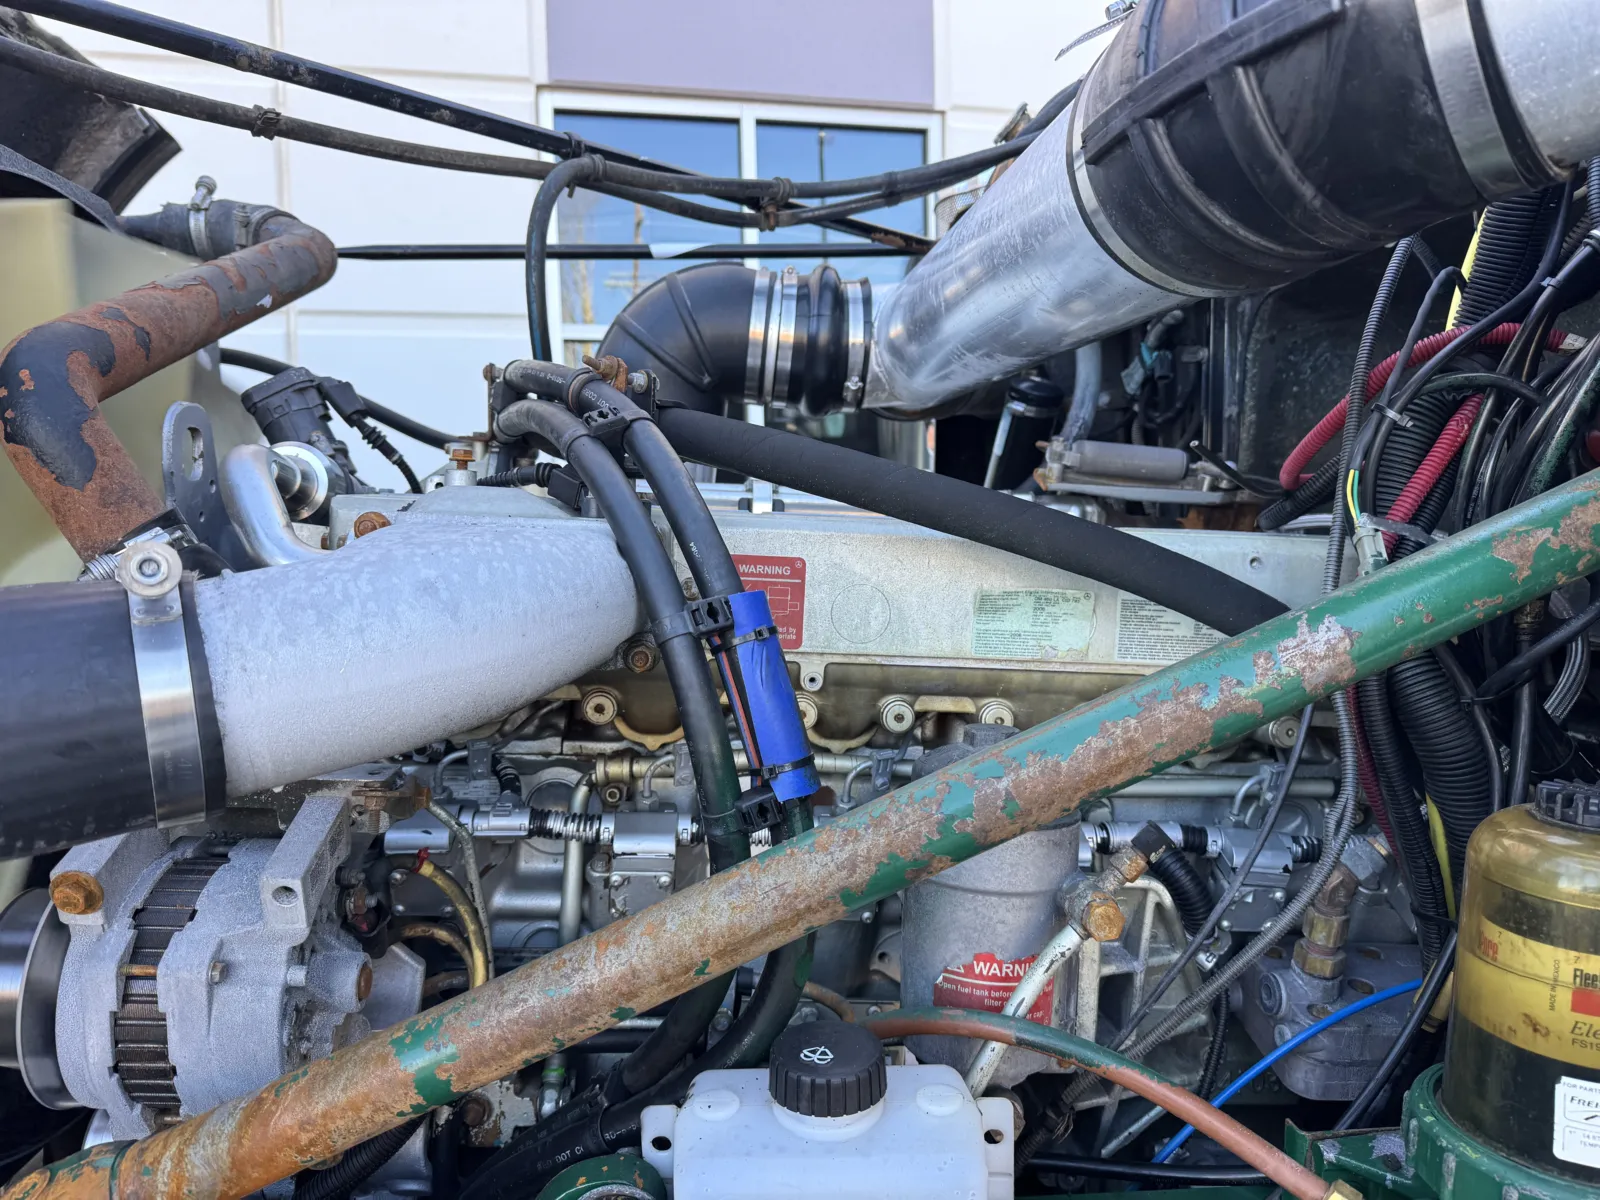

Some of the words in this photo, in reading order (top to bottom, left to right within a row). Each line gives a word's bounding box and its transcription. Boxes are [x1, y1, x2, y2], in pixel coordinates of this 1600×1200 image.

[739, 564, 791, 575] WARNING
[973, 961, 1032, 977] WARNI
[1552, 959, 1560, 983] MEXICO
[1573, 967, 1600, 989] Flee
[939, 981, 956, 990] Open
[957, 985, 972, 994] fuel
[973, 987, 989, 997] tank
[984, 998, 1001, 1007] filter
[1548, 993, 1557, 1012] MADE
[1570, 1020, 1600, 1040] Ele
[1563, 1081, 1577, 1089] FOR
[1570, 1096, 1600, 1109] FREI
